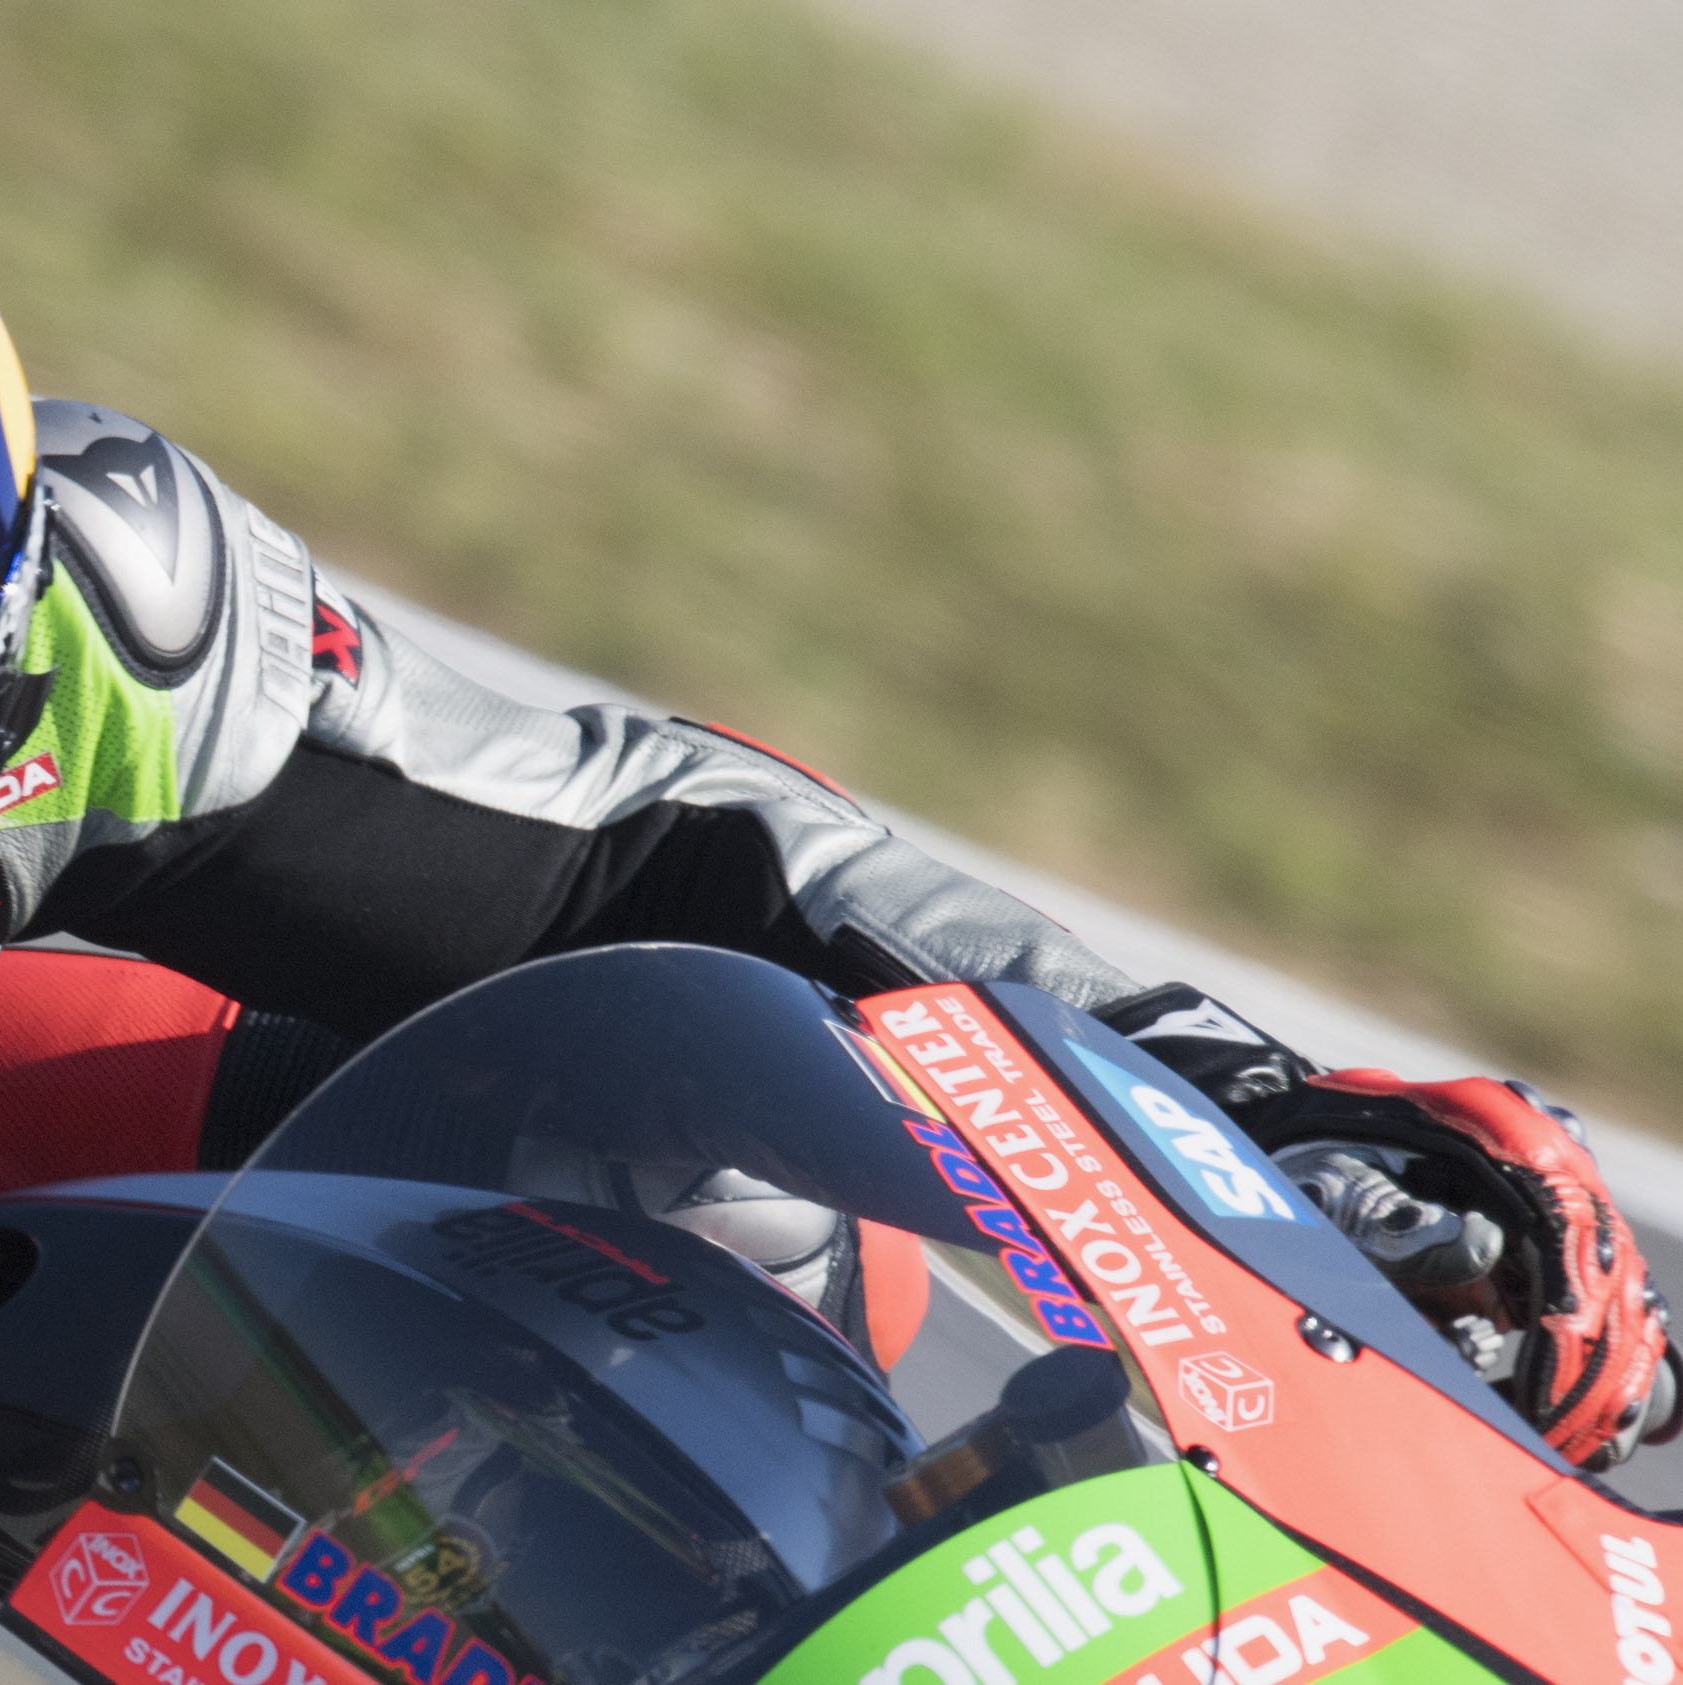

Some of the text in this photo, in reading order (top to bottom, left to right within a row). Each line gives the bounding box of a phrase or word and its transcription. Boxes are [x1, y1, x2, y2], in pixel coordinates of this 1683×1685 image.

[880, 1000, 1195, 1347] INOX CENTER
[902, 1119, 1117, 1350] BRADL
[934, 996, 1227, 1335] STAINLESS STEEL TRADE
[1130, 1084, 1292, 1221] SAP
[276, 1528, 543, 1685] BRAD
[1600, 1533, 1676, 1685] OTUL
